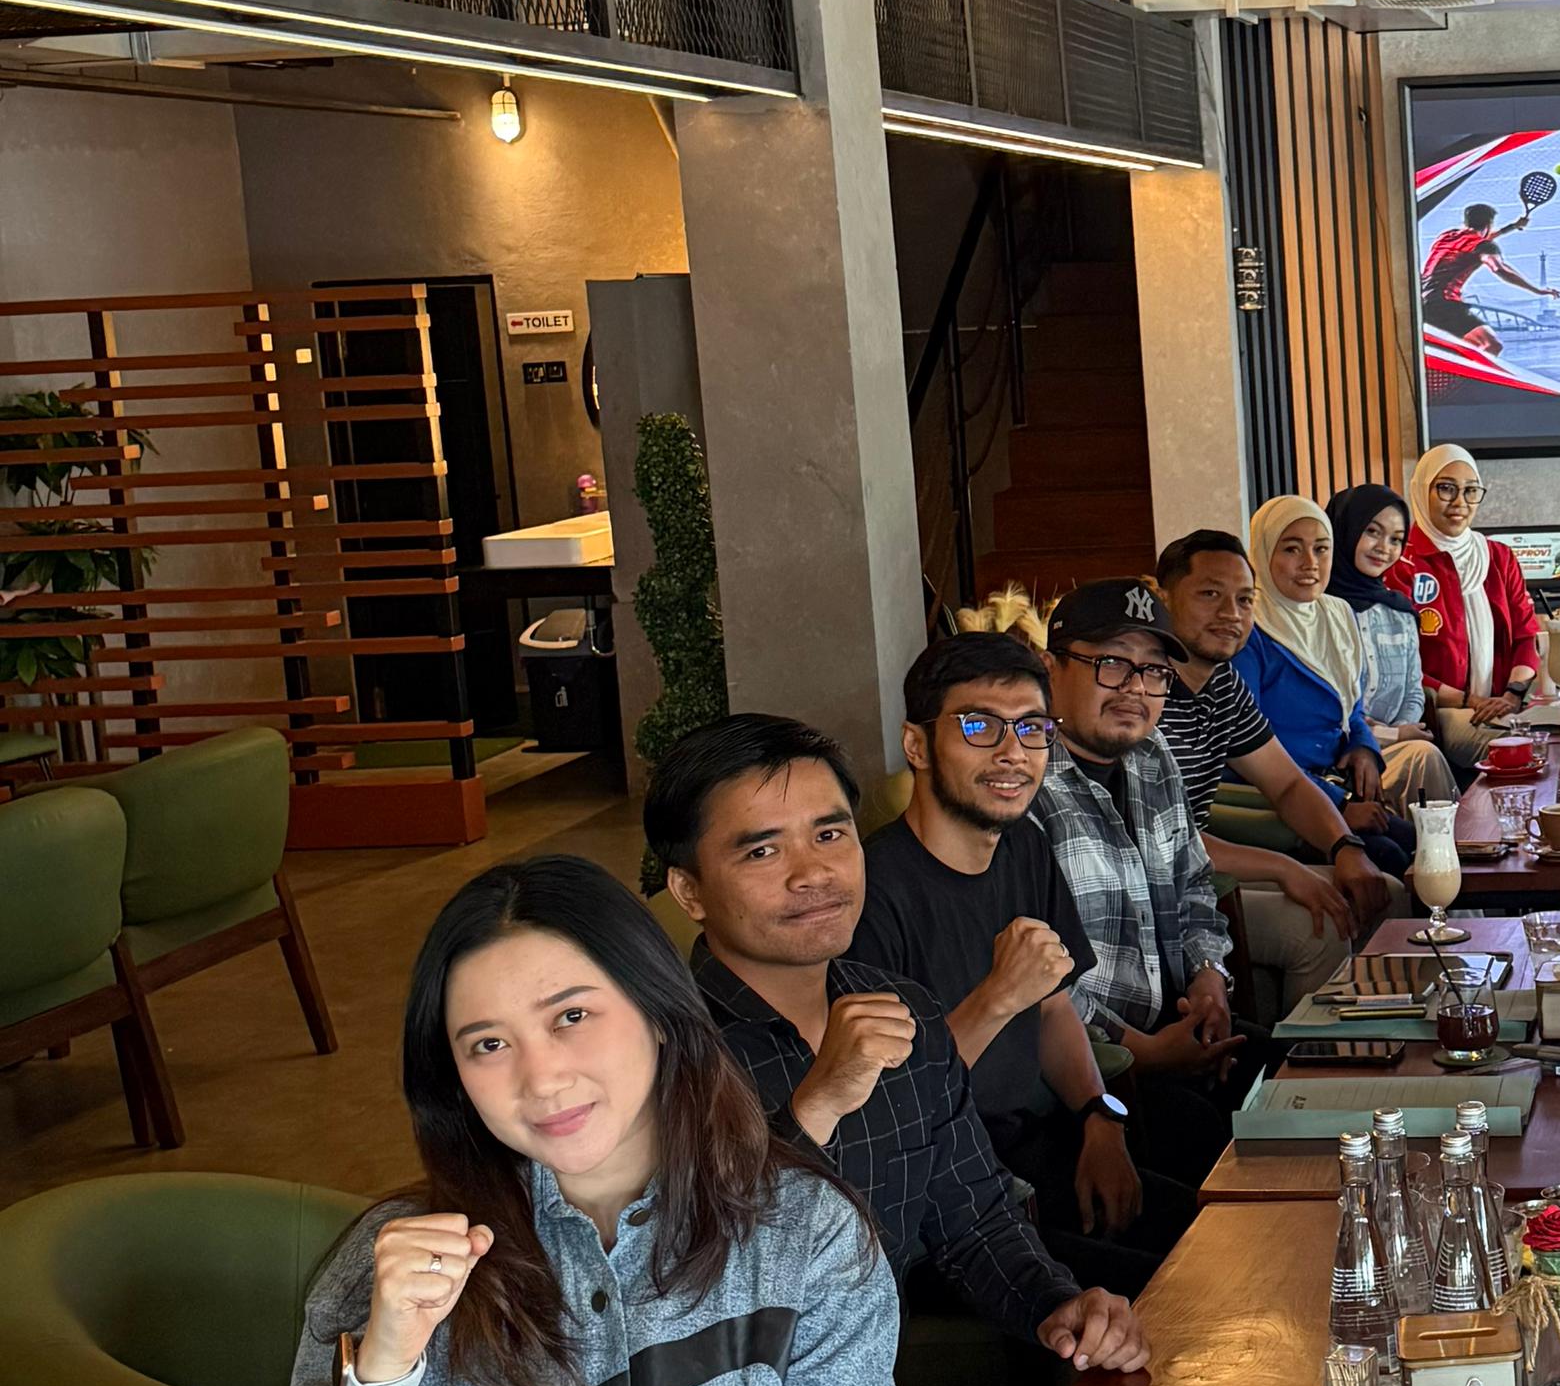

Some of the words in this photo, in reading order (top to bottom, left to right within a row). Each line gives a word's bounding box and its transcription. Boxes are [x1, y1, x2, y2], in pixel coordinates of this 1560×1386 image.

[523, 315, 569, 329] TOILET
[1414, 574, 1435, 603] hp
[1124, 586, 1155, 623] NY
